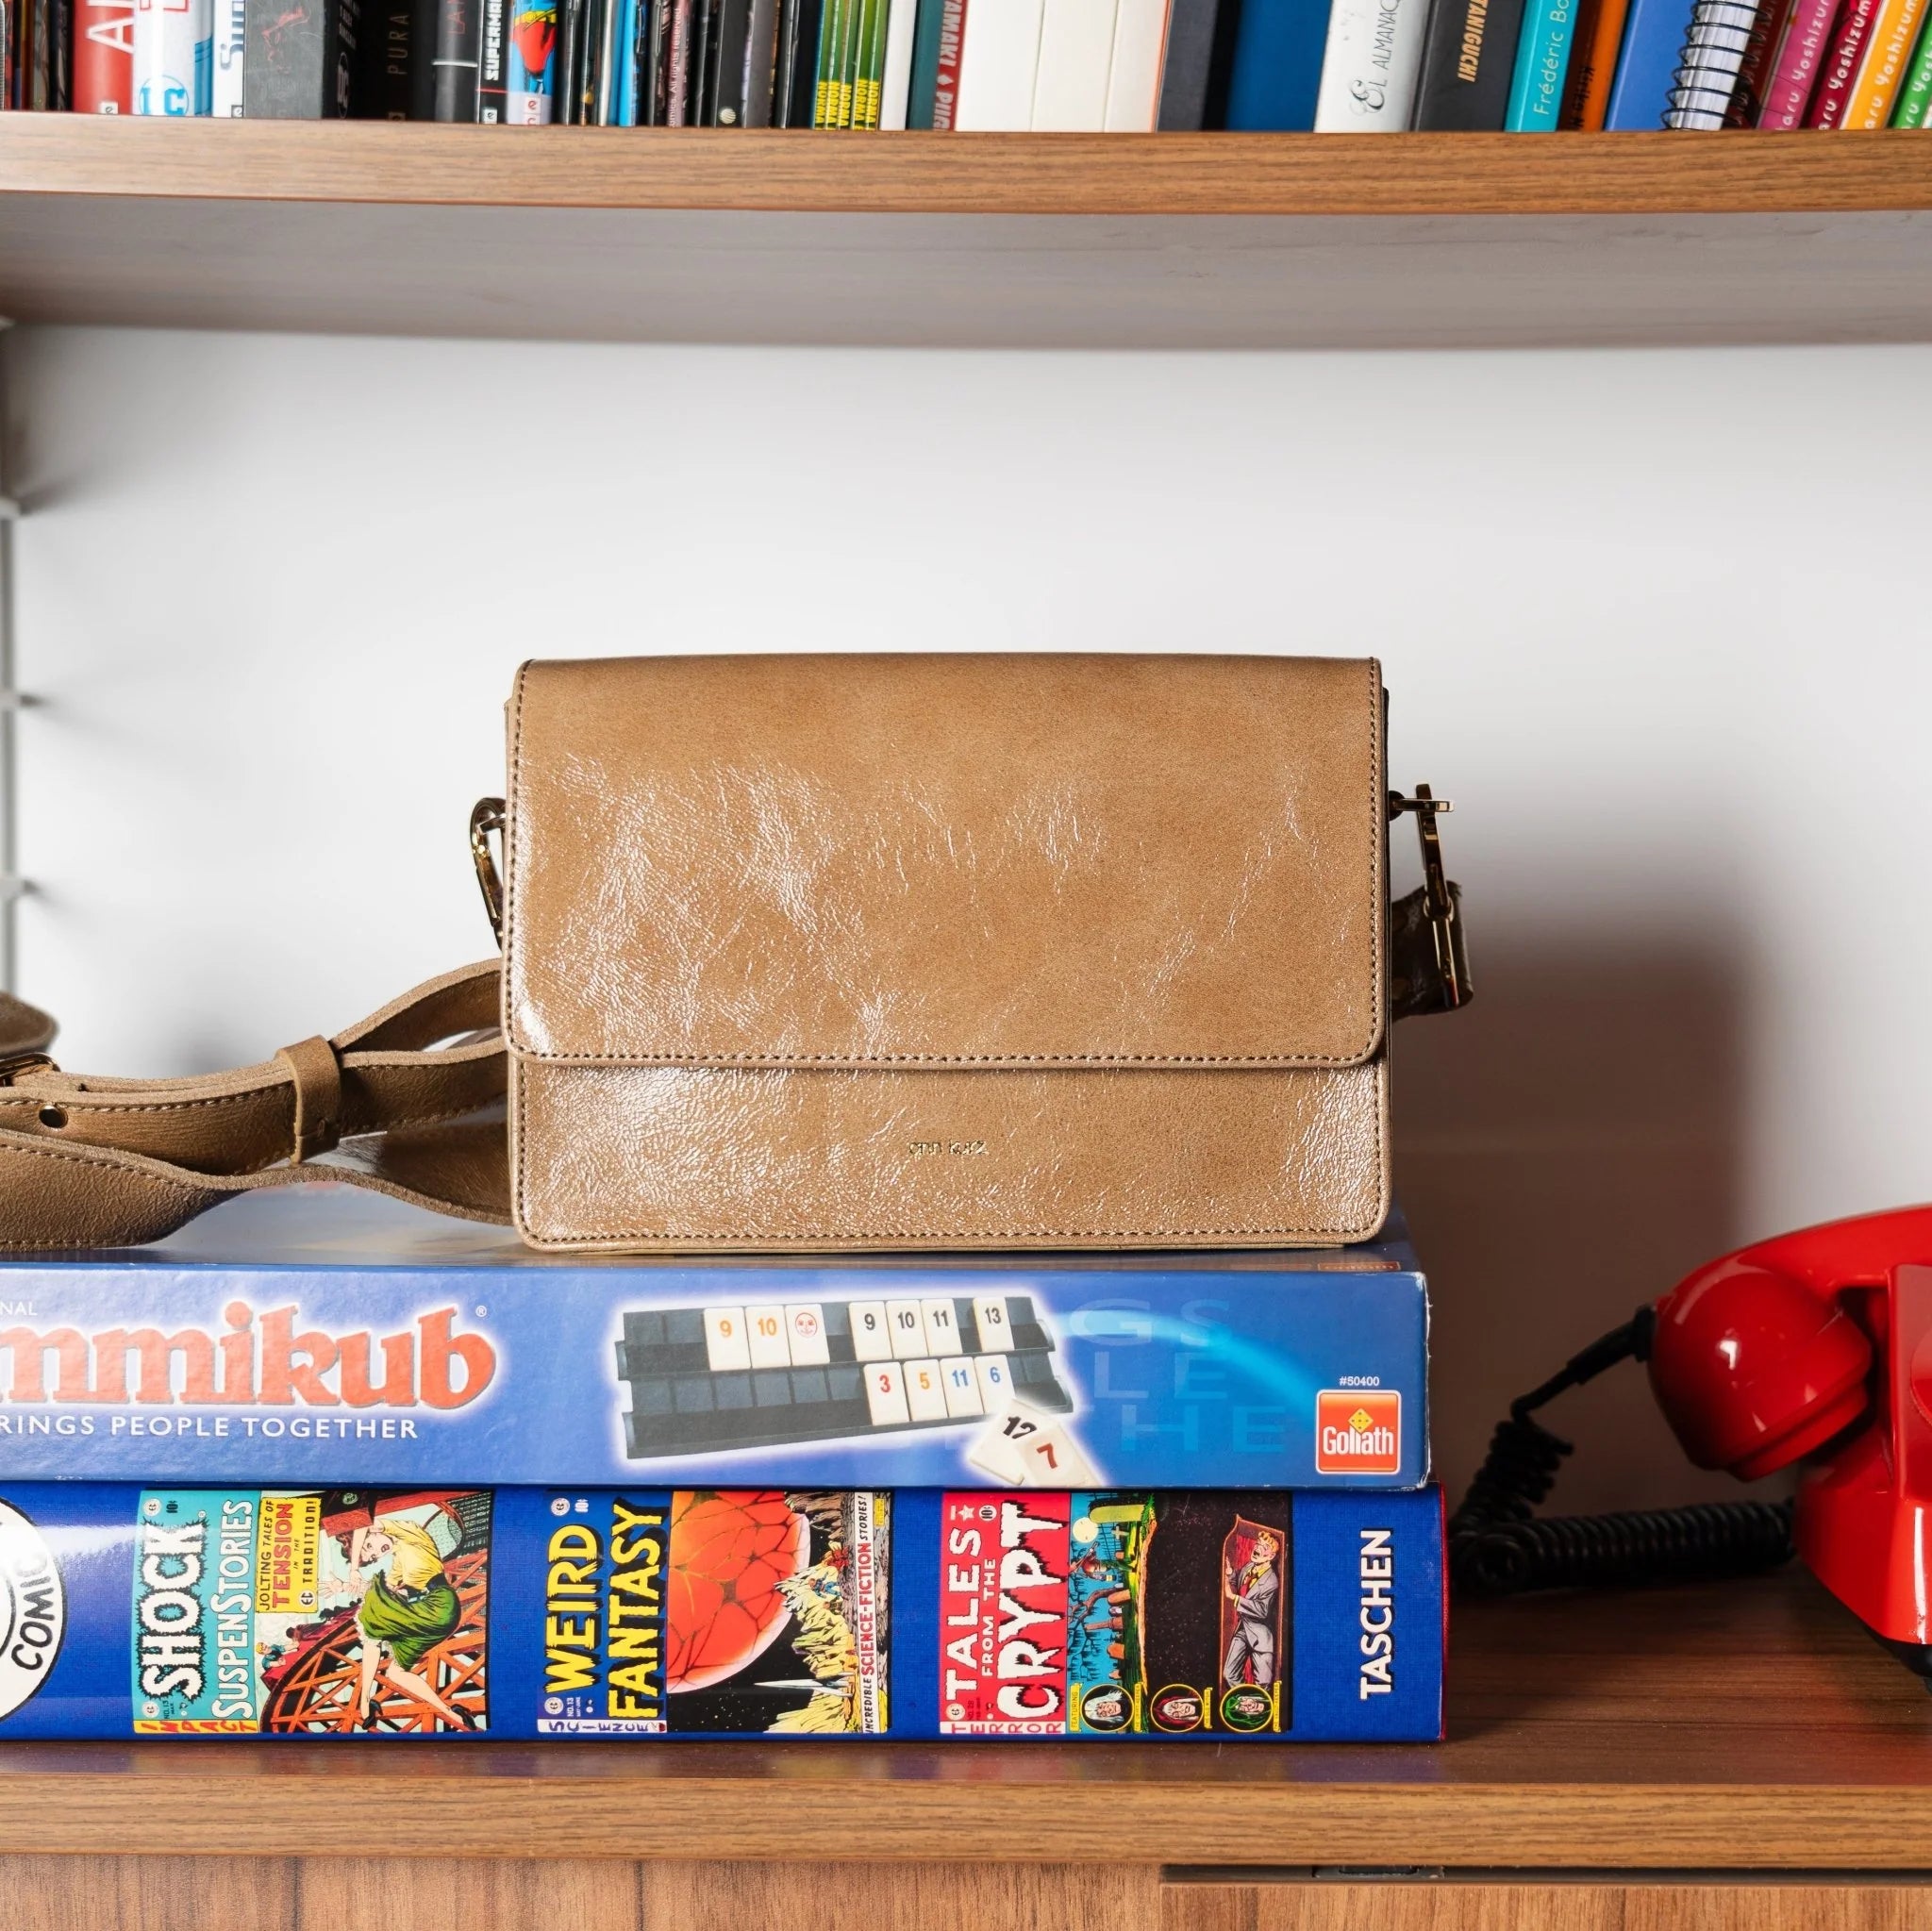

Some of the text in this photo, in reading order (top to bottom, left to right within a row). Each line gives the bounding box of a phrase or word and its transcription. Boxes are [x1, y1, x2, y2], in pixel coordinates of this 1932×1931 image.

[86, 0, 133, 54] A
[388, 15, 409, 74] PURA
[484, 0, 502, 81] SUPERMA
[1533, 31, 1564, 114] Frédéric
[815, 81, 828, 124] NORMA
[826, 81, 840, 124] NORMA
[838, 84, 852, 126] NORMA
[854, 79, 868, 122] NORMA
[866, 81, 879, 124] NORMA
[1774, 92, 1801, 130] aru
[719, 1307, 1003, 1338] 9 10 9 10 11 13
[0, 1302, 498, 1410] mmikub
[878, 1366, 1001, 1393] 3 5 11 6
[1339, 1375, 1381, 1387] #50400
[110, 1416, 229, 1438] PEOPLE
[244, 1417, 418, 1440] TOGETHER
[1003, 1416, 1037, 1439] 12
[1323, 1425, 1394, 1456] Goliath
[1036, 1442, 1058, 1469] 7
[259, 1500, 275, 1611] JOLTING TALES OF
[272, 1503, 294, 1606] TENSION
[292, 1560, 299, 1570] IN
[140, 1517, 208, 1703] SHOCK
[544, 1524, 600, 1693] WEIRD
[608, 1501, 663, 1719] FANTASY
[858, 1495, 874, 1734] INCREDIBLE SCIENCE-FICTION STORIES!
[945, 1528, 981, 1701] TALES
[981, 1558, 996, 1677] FROM THE
[996, 1501, 1068, 1719] CRYPT
[1359, 1530, 1392, 1701] TASCHEN
[142, 1721, 257, 1733] IMPACT
[548, 1721, 649, 1733] SCIENCE
[950, 1722, 1063, 1735] TERROR
[1071, 1690, 1079, 1729] FEATURING
